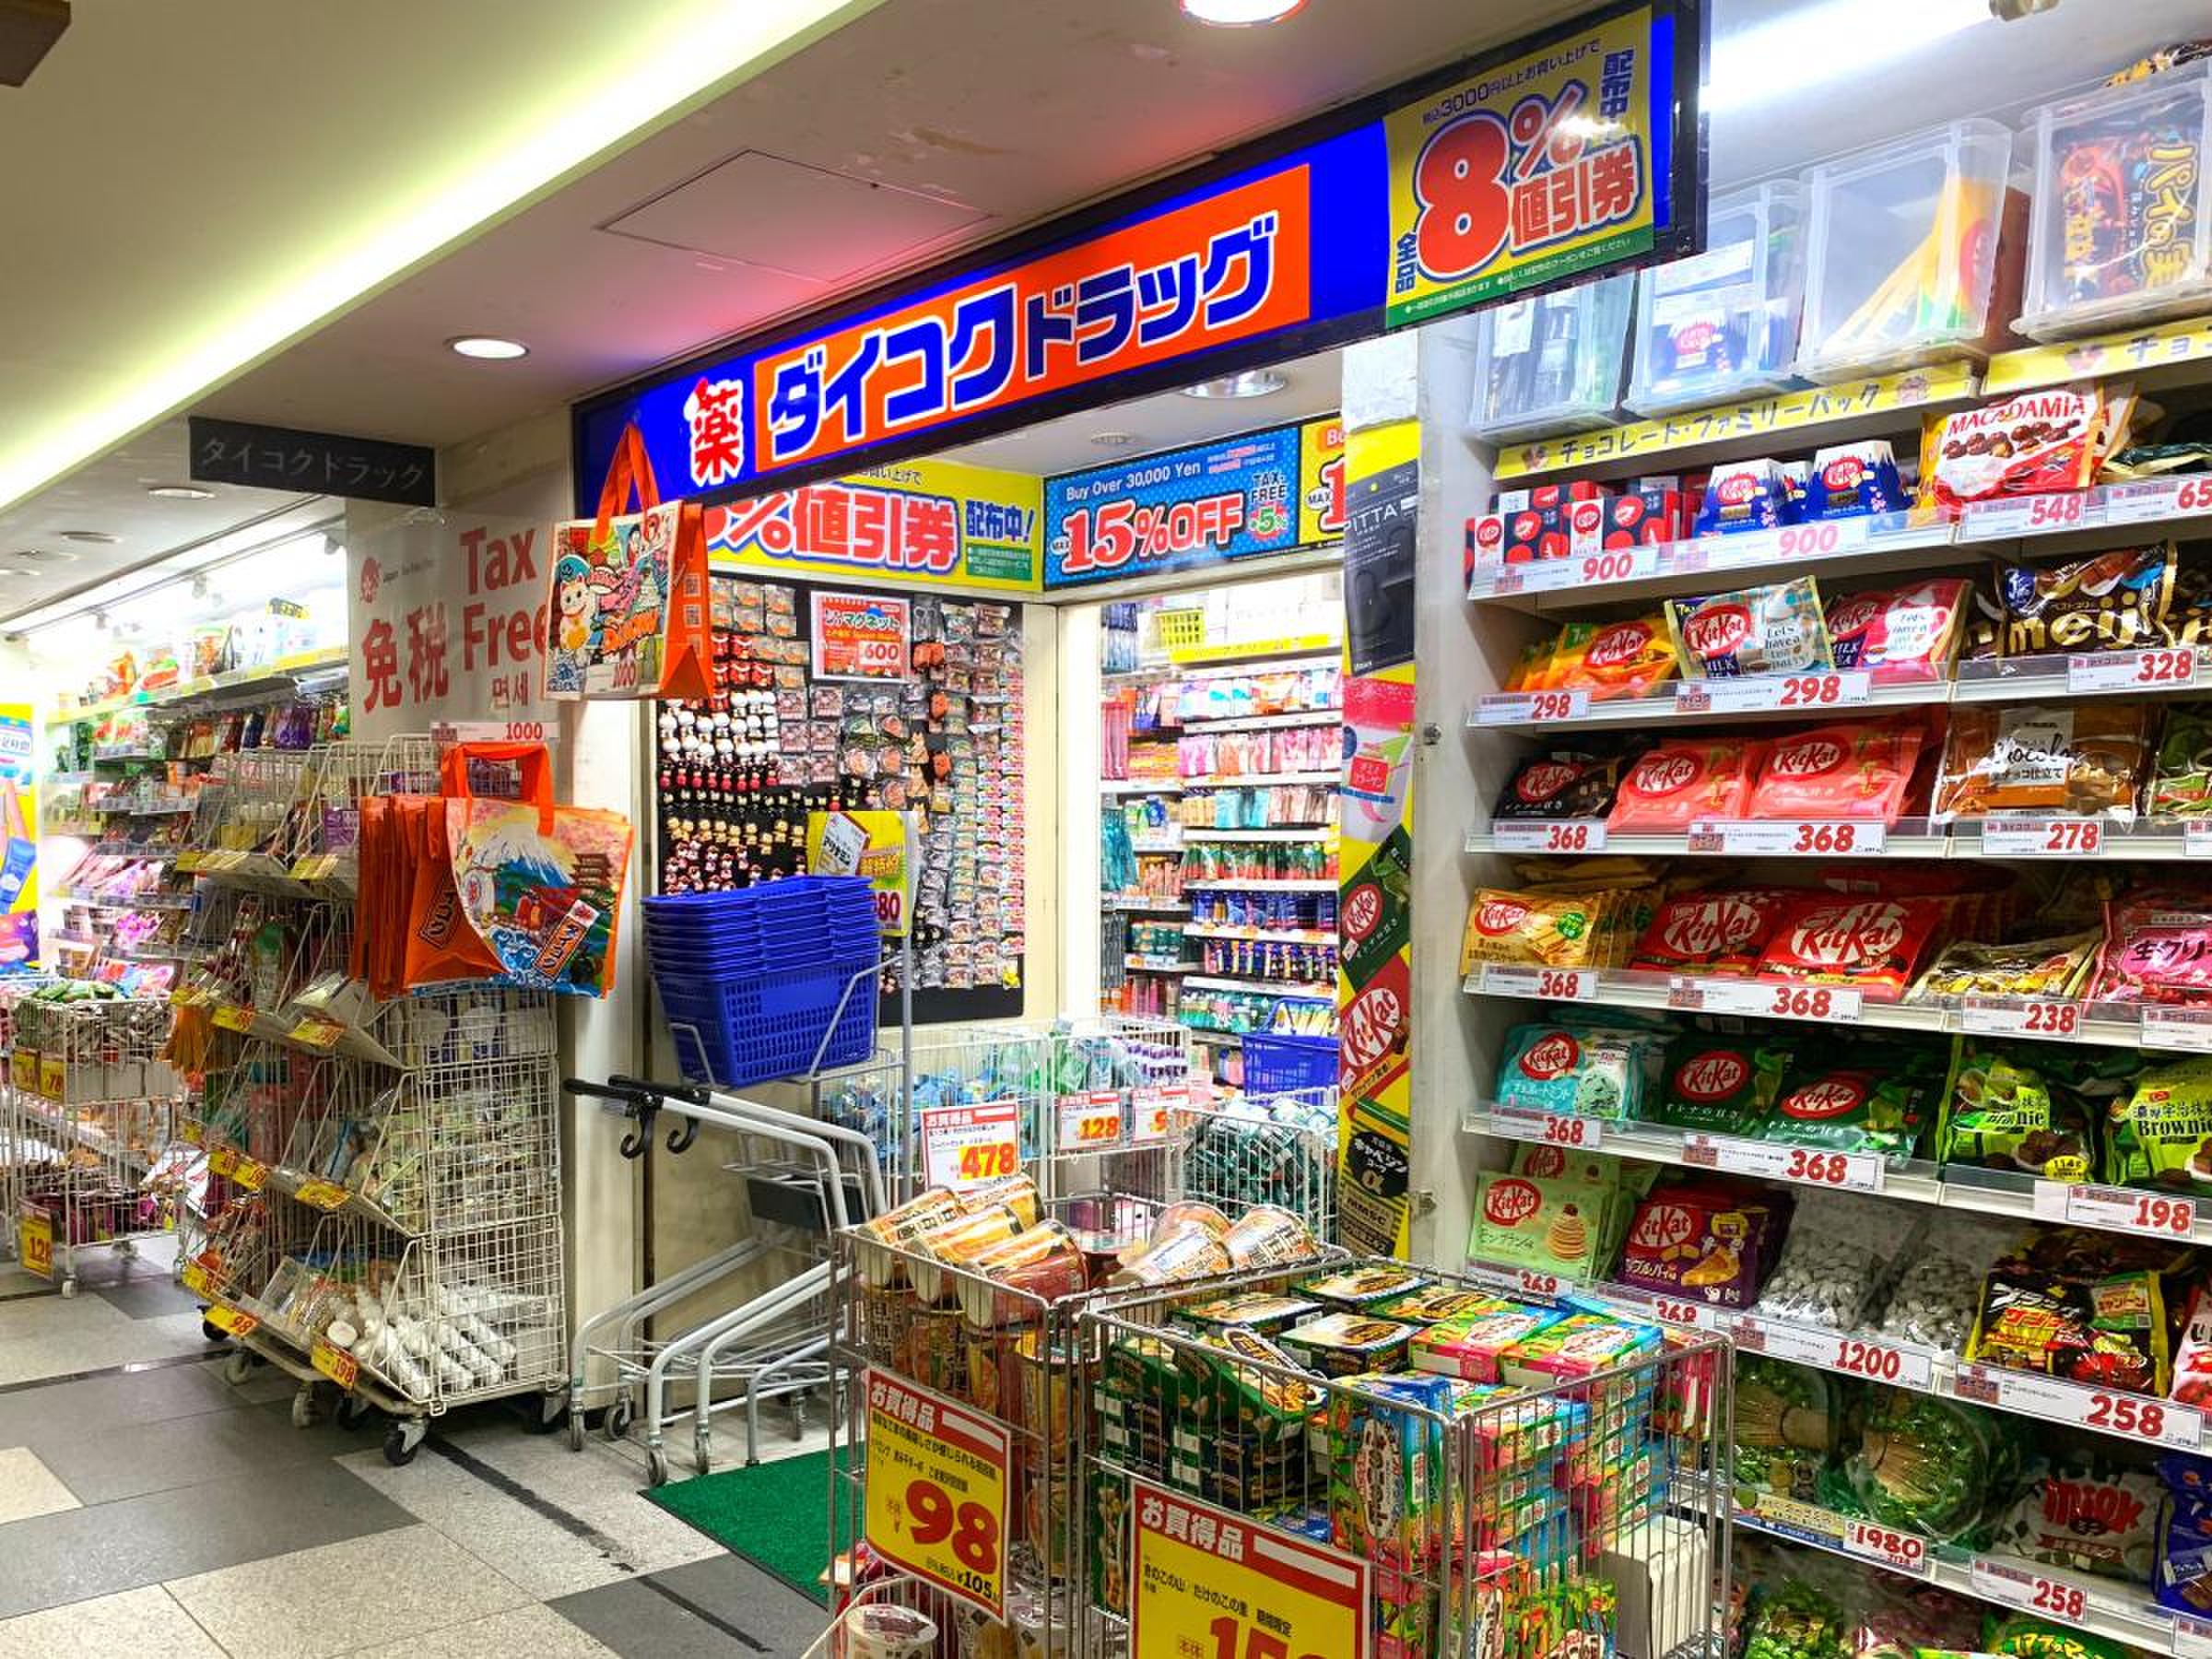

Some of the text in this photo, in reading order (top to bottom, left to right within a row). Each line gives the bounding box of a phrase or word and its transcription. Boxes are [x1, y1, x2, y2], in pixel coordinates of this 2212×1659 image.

[1417, 83, 1637, 274] 8% 値引券
[1395, 234, 1418, 294] 全品
[767, 210, 1278, 463] ダイコクドラッグ
[2127, 324, 2212, 362] チョ
[691, 380, 743, 486] 薬
[1948, 393, 2086, 437] MACADAMIA
[1065, 460, 1201, 501] Buy Over 30,000 Yen
[1251, 485, 1287, 504] FREE
[793, 486, 957, 571] 値引券
[2030, 496, 2082, 525] 548
[1064, 494, 1242, 571] 15%OFF
[1779, 524, 1840, 557] 900
[461, 527, 537, 595] Tax
[1583, 555, 1633, 582] 900
[1692, 610, 1748, 654] KitKat
[361, 604, 451, 713] 免税
[864, 642, 900, 662] 600
[2136, 649, 2193, 682] 328
[1531, 694, 1571, 719] 298
[1780, 677, 1841, 706] 298
[505, 722, 543, 740] 1000
[1637, 749, 1696, 790] KitKat
[1775, 739, 1842, 778] KitKat
[1547, 824, 1587, 851] 368
[1794, 824, 1855, 853] 368
[2045, 823, 2099, 852] 278
[1670, 901, 1760, 953] KitKat
[1795, 907, 1902, 964] KitKat
[1538, 971, 1579, 999] 368
[1771, 987, 1832, 1018] 368
[2025, 1003, 2078, 1033] 238
[1526, 1036, 1572, 1071] KitKat
[1687, 1055, 1743, 1092] KitKat
[1790, 1084, 1856, 1115] KitKat
[1078, 1115, 1121, 1140] 128
[1544, 1117, 1584, 1144] 368
[959, 1143, 1015, 1178] 478
[1785, 1149, 1849, 1184] 368
[1488, 1186, 1535, 1218] KitKat
[2135, 1197, 2192, 1233] 198
[1637, 1206, 1694, 1245] KitKat
[1833, 1341, 1902, 1382] 1200
[2085, 1394, 2165, 1439] 258
[904, 1478, 999, 1576] 98
[1142, 1497, 1244, 1562] お買得品
[1855, 1524, 1923, 1560] 1980
[2033, 1580, 2085, 1618] 258
